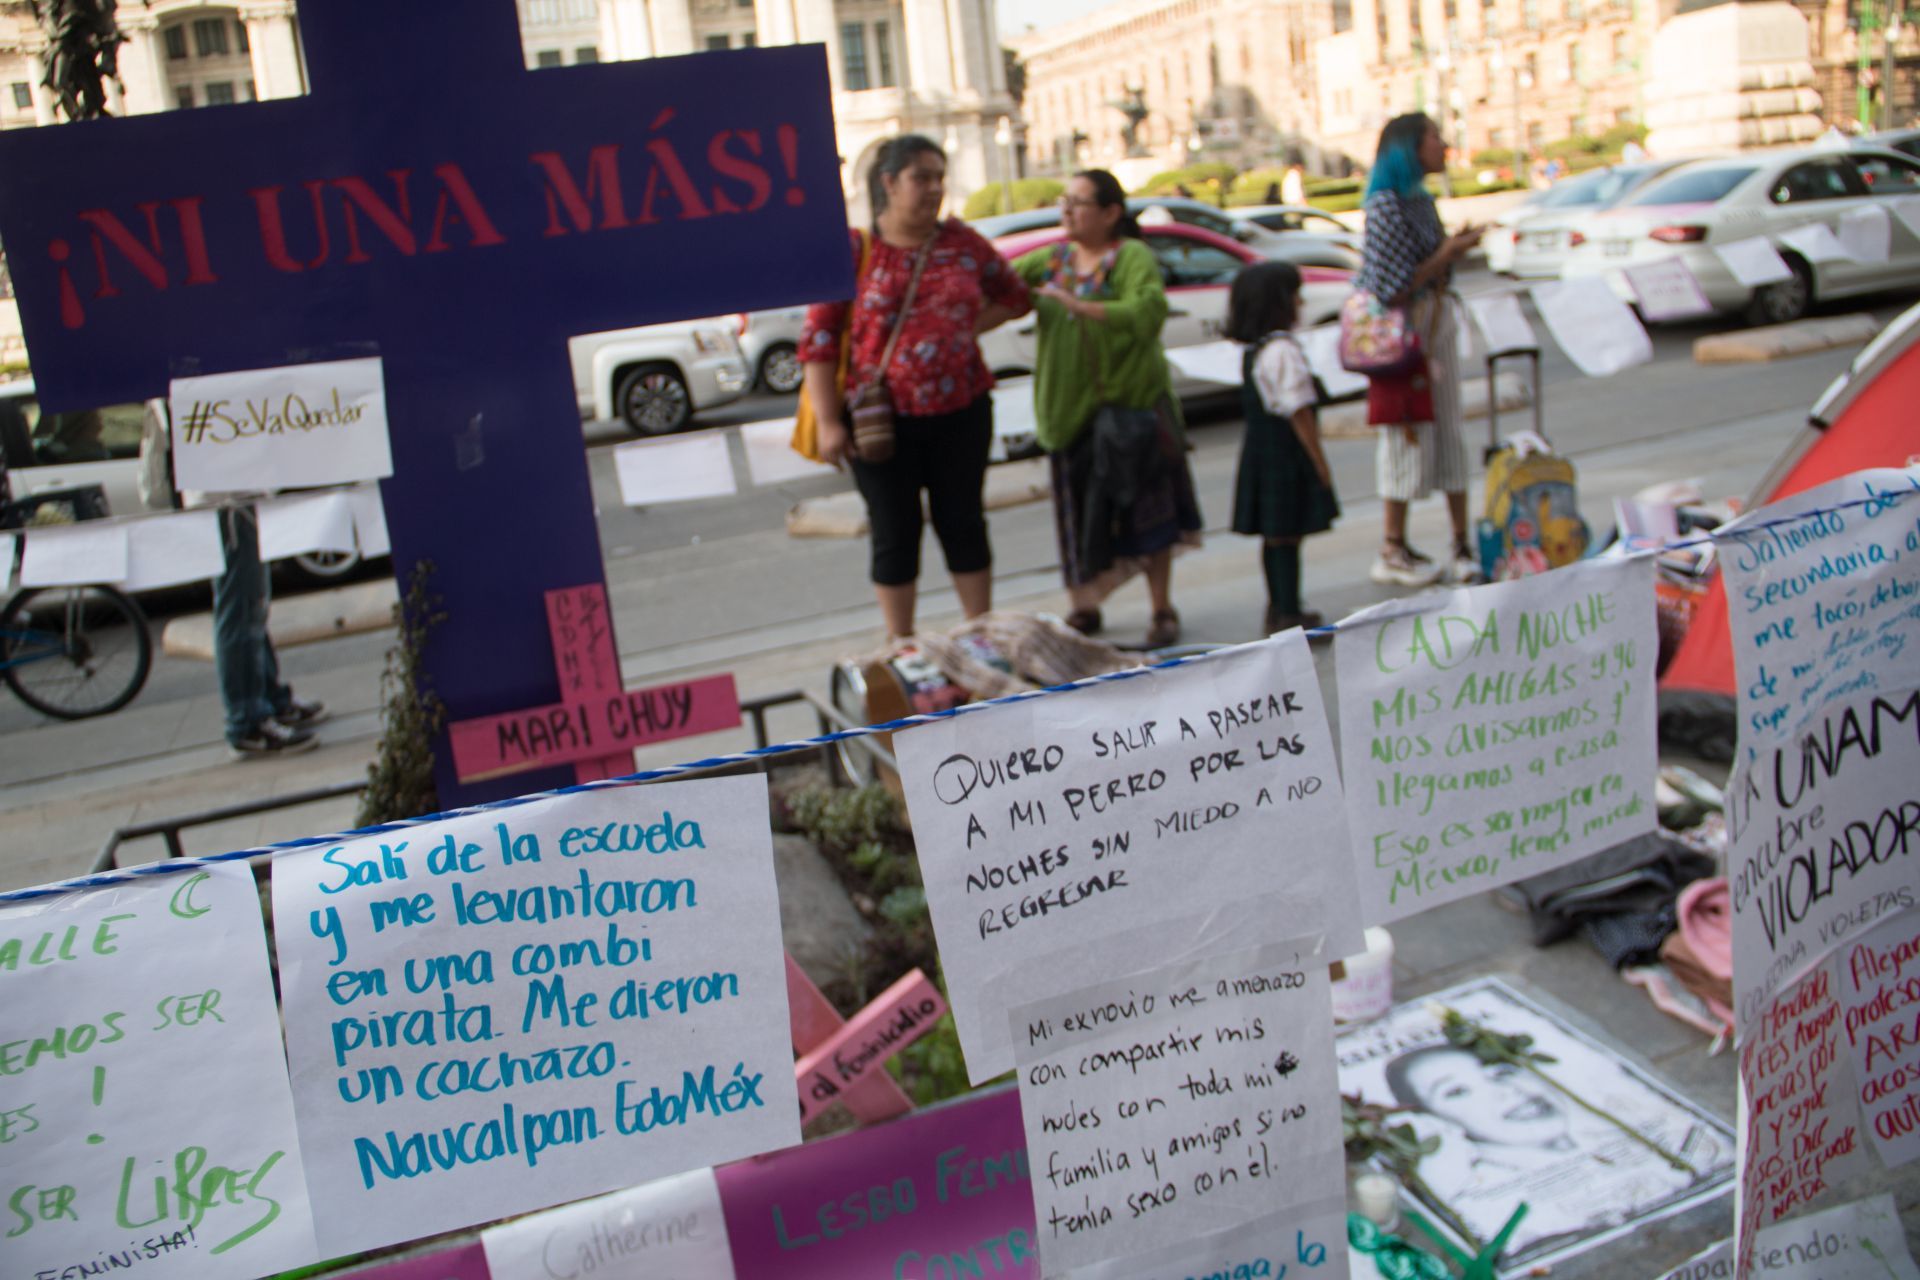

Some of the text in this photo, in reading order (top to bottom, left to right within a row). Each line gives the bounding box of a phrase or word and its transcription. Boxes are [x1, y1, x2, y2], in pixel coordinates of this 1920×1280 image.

[47, 107, 806, 330] ¡NI UNA MÁS!
[1864, 482, 1902, 518] de
[1376, 592, 1617, 674] CADA NOCHE
[1755, 617, 1799, 649] me
[1372, 686, 1441, 729] MIS
[1453, 661, 1577, 711] AMIGAS
[1749, 664, 1778, 700] de
[497, 686, 692, 760] MARI CHUY
[934, 690, 1304, 806] QUIERO SALIR A PASEAR
[1371, 733, 1433, 764] NOS
[1445, 698, 1598, 758] avisamos
[1774, 689, 1920, 810] UNAM
[965, 733, 1306, 850] A MI PERRO POR LAS
[1376, 729, 1619, 817] llegamos a casa
[318, 810, 707, 894] Salí de la escuela
[966, 775, 1323, 895] NOCHES SIN MIEDO A NO
[1372, 829, 1430, 870] Eso
[1440, 822, 1475, 849] es
[978, 869, 1130, 940] REGRESAR
[1757, 801, 1920, 952] VIOLADOR
[309, 867, 698, 966] y me levantaron
[1818, 886, 1915, 945] VIOLETAS
[325, 923, 653, 1006] en una combi
[153, 988, 226, 1032] SER
[330, 970, 740, 1068] pirata. Me dieron
[1028, 1017, 1055, 1048] Mi
[1168, 986, 1208, 1010] me
[337, 1065, 404, 1105] un
[1029, 1017, 1266, 1087] con compartir mis
[1117, 1095, 1166, 1121] con
[1177, 1067, 1234, 1102] toda
[1244, 1062, 1274, 1090] mi
[1045, 1146, 1131, 1191] familia
[1142, 1147, 1161, 1184] y
[1167, 1117, 1243, 1160] amigos
[6, 1183, 79, 1238] SER
[770, 1176, 918, 1251] LESBO
[1049, 1193, 1113, 1240] tenía
[1127, 1182, 1177, 1220] sexo
[1194, 1166, 1239, 1197] con
[542, 1211, 706, 1279] Catherine
[1296, 1229, 1327, 1268] la
